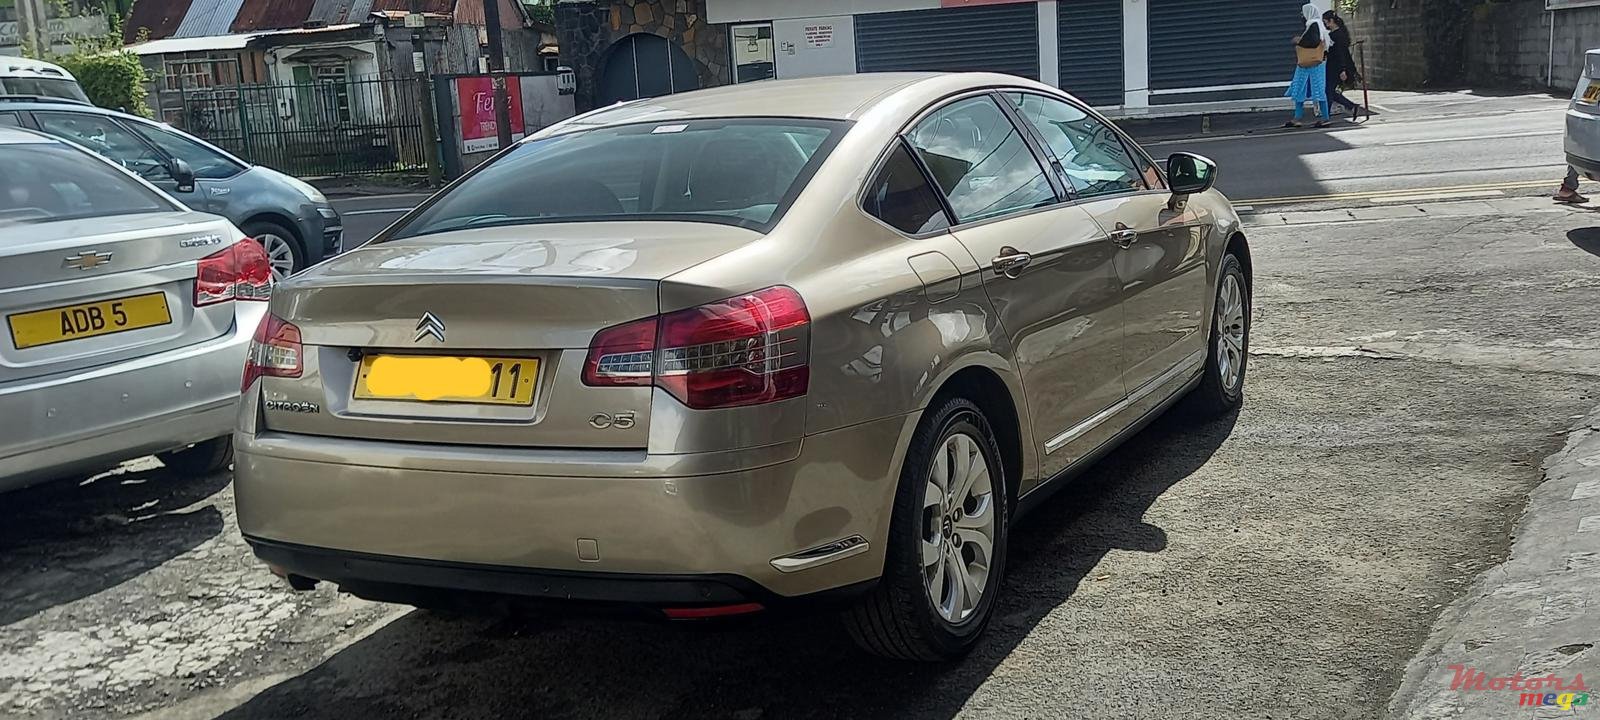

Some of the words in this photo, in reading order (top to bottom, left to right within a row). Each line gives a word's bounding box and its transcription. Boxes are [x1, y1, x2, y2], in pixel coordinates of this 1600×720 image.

[60, 306, 105, 336] ADB
[112, 302, 127, 326] 5
[491, 362, 521, 399] 11
[588, 410, 635, 429] C5
